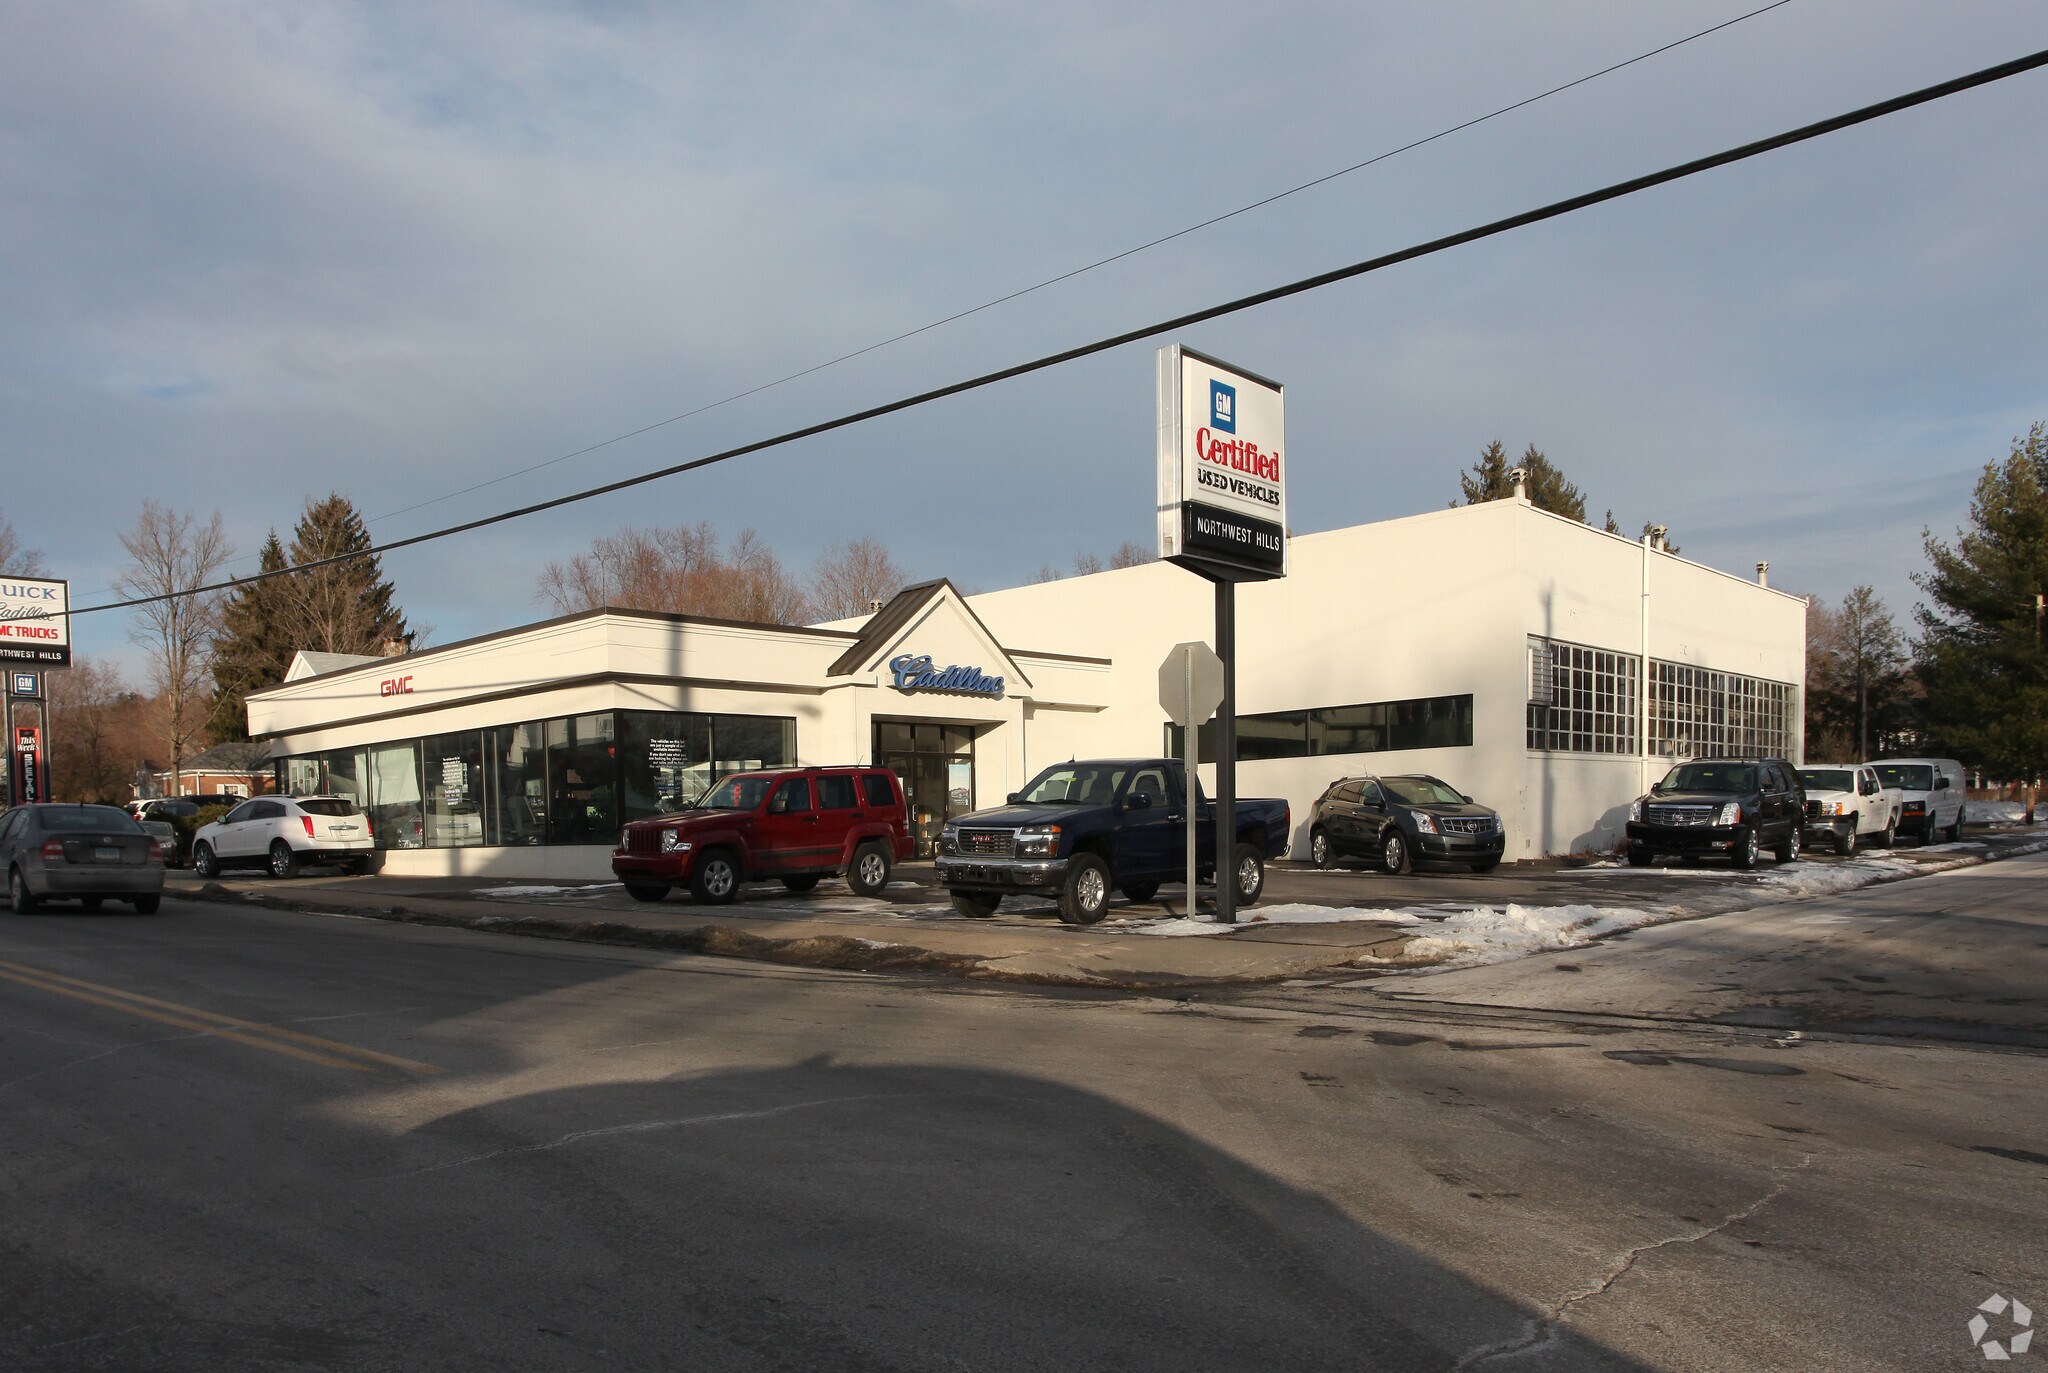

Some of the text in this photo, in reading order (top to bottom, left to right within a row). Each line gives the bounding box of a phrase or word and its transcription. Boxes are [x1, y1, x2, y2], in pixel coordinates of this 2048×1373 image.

[1216, 392, 1230, 415] GM
[1196, 427, 1280, 482] Certified
[1197, 468, 1280, 505] USED VEHICLES
[1197, 517, 1280, 551] NORTHWEST HILLS
[0, 584, 57, 600] UICK
[0, 625, 58, 639] MC TRUCKS
[0, 649, 62, 660] RTHWEST HILLS
[18, 677, 33, 688] GM
[888, 653, 1005, 694] Cadillac
[380, 675, 413, 698] GMC
